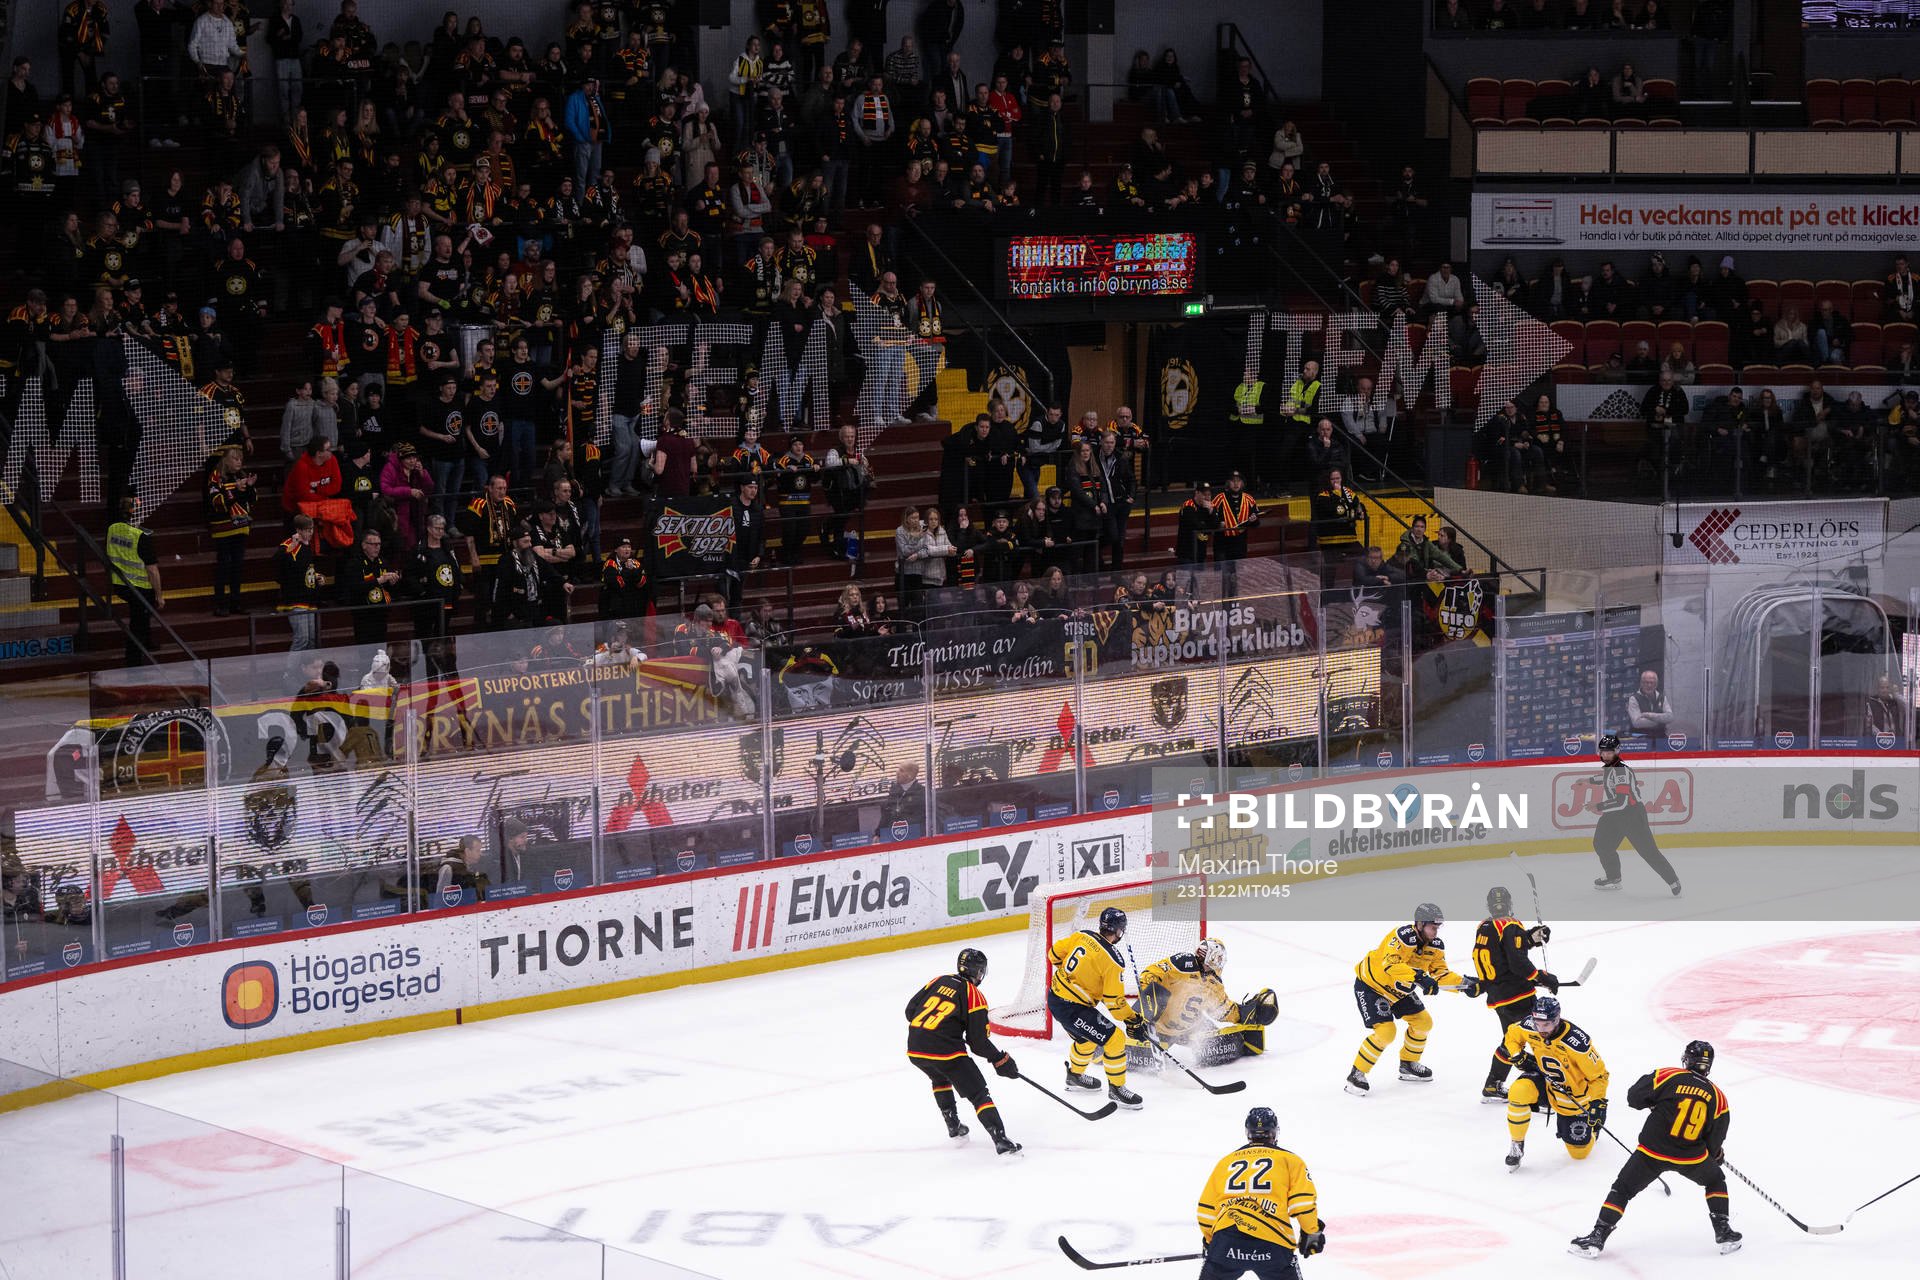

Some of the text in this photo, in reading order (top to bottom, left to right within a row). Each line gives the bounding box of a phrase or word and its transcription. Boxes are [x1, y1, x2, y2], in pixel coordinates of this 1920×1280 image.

[1580, 202, 1919, 230] Hela veckans mat på ett klick!
[1579, 231, 1616, 241] Handla
[1624, 230, 1639, 241] vår
[1642, 231, 1666, 241] butik
[1668, 230, 1682, 244] på
[1684, 231, 1713, 241] nätet.
[1715, 232, 1740, 241] Alltid
[1742, 231, 1772, 244] öppet
[1775, 232, 1810, 244] dygnet
[1812, 232, 1833, 242] runt
[1835, 231, 1849, 243] på
[1012, 243, 1087, 267] FIRMAFEST?
[1012, 276, 1188, 296] kontakta info@brynas.se
[653, 515, 736, 536] SEKTION
[1733, 518, 1859, 541] CEDERLÖFS
[690, 536, 728, 555] 1912
[1734, 539, 1859, 551] PLATTSÄTTNING AB
[1064, 622, 1096, 637] STISSE
[1175, 603, 1256, 634] Brynäs
[1440, 610, 1475, 628] TIFO
[887, 636, 1017, 668] Till minne av
[484, 667, 632, 695] SUPPORTERKLUBBEN
[852, 680, 906, 701] Sören
[995, 656, 1054, 683] Stellin
[1782, 769, 1899, 820] nds
[1057, 843, 1064, 855] AV
[1076, 842, 1120, 879] XL
[788, 864, 911, 925] Elvida
[480, 906, 695, 980] THORNE
[784, 916, 907, 943] ETT FÖRETAG INOM KRAFTKONSULT
[291, 944, 422, 986] Höganäs
[1066, 946, 1086, 974] 6
[292, 967, 442, 1015] Borgestad
[911, 995, 956, 1031] 23
[1074, 1016, 1107, 1043] Dialect
[1670, 1098, 1708, 1141] 19
[1224, 1157, 1273, 1195] 22
[1226, 1247, 1272, 1261] Ahréns
